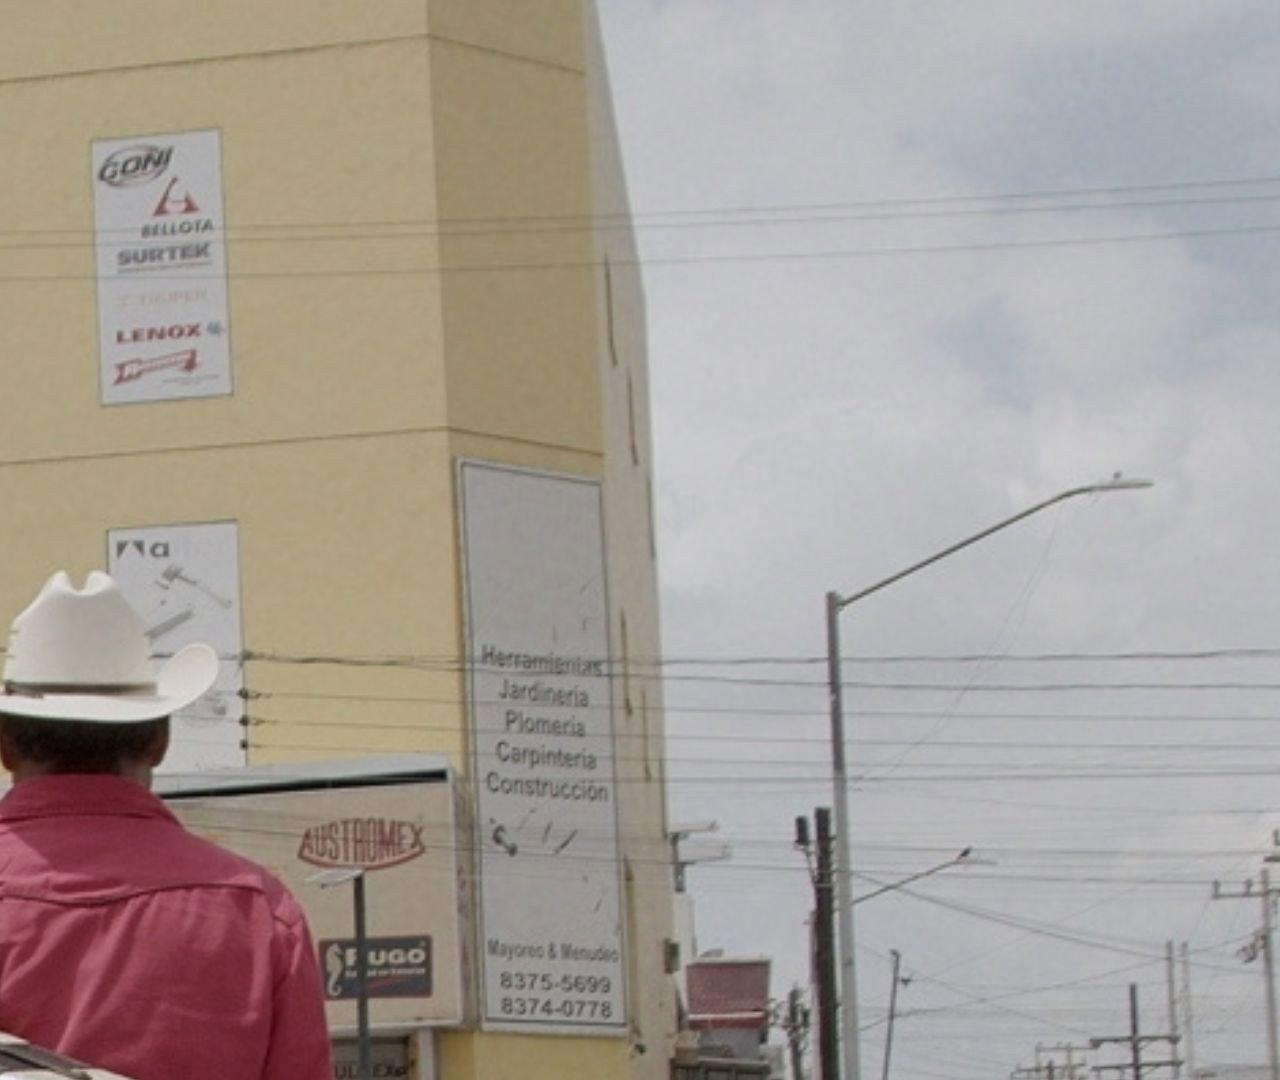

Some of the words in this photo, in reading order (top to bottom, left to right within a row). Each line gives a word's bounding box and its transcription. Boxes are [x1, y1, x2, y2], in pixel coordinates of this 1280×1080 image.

[140, 217, 215, 239] BELLOTA
[116, 241, 212, 266] SURTEK
[115, 322, 202, 344] LENOX
[481, 644, 603, 677] Herramientas
[299, 817, 426, 863] AUSTROMEX
[500, 996, 613, 1019] 8374-0778
